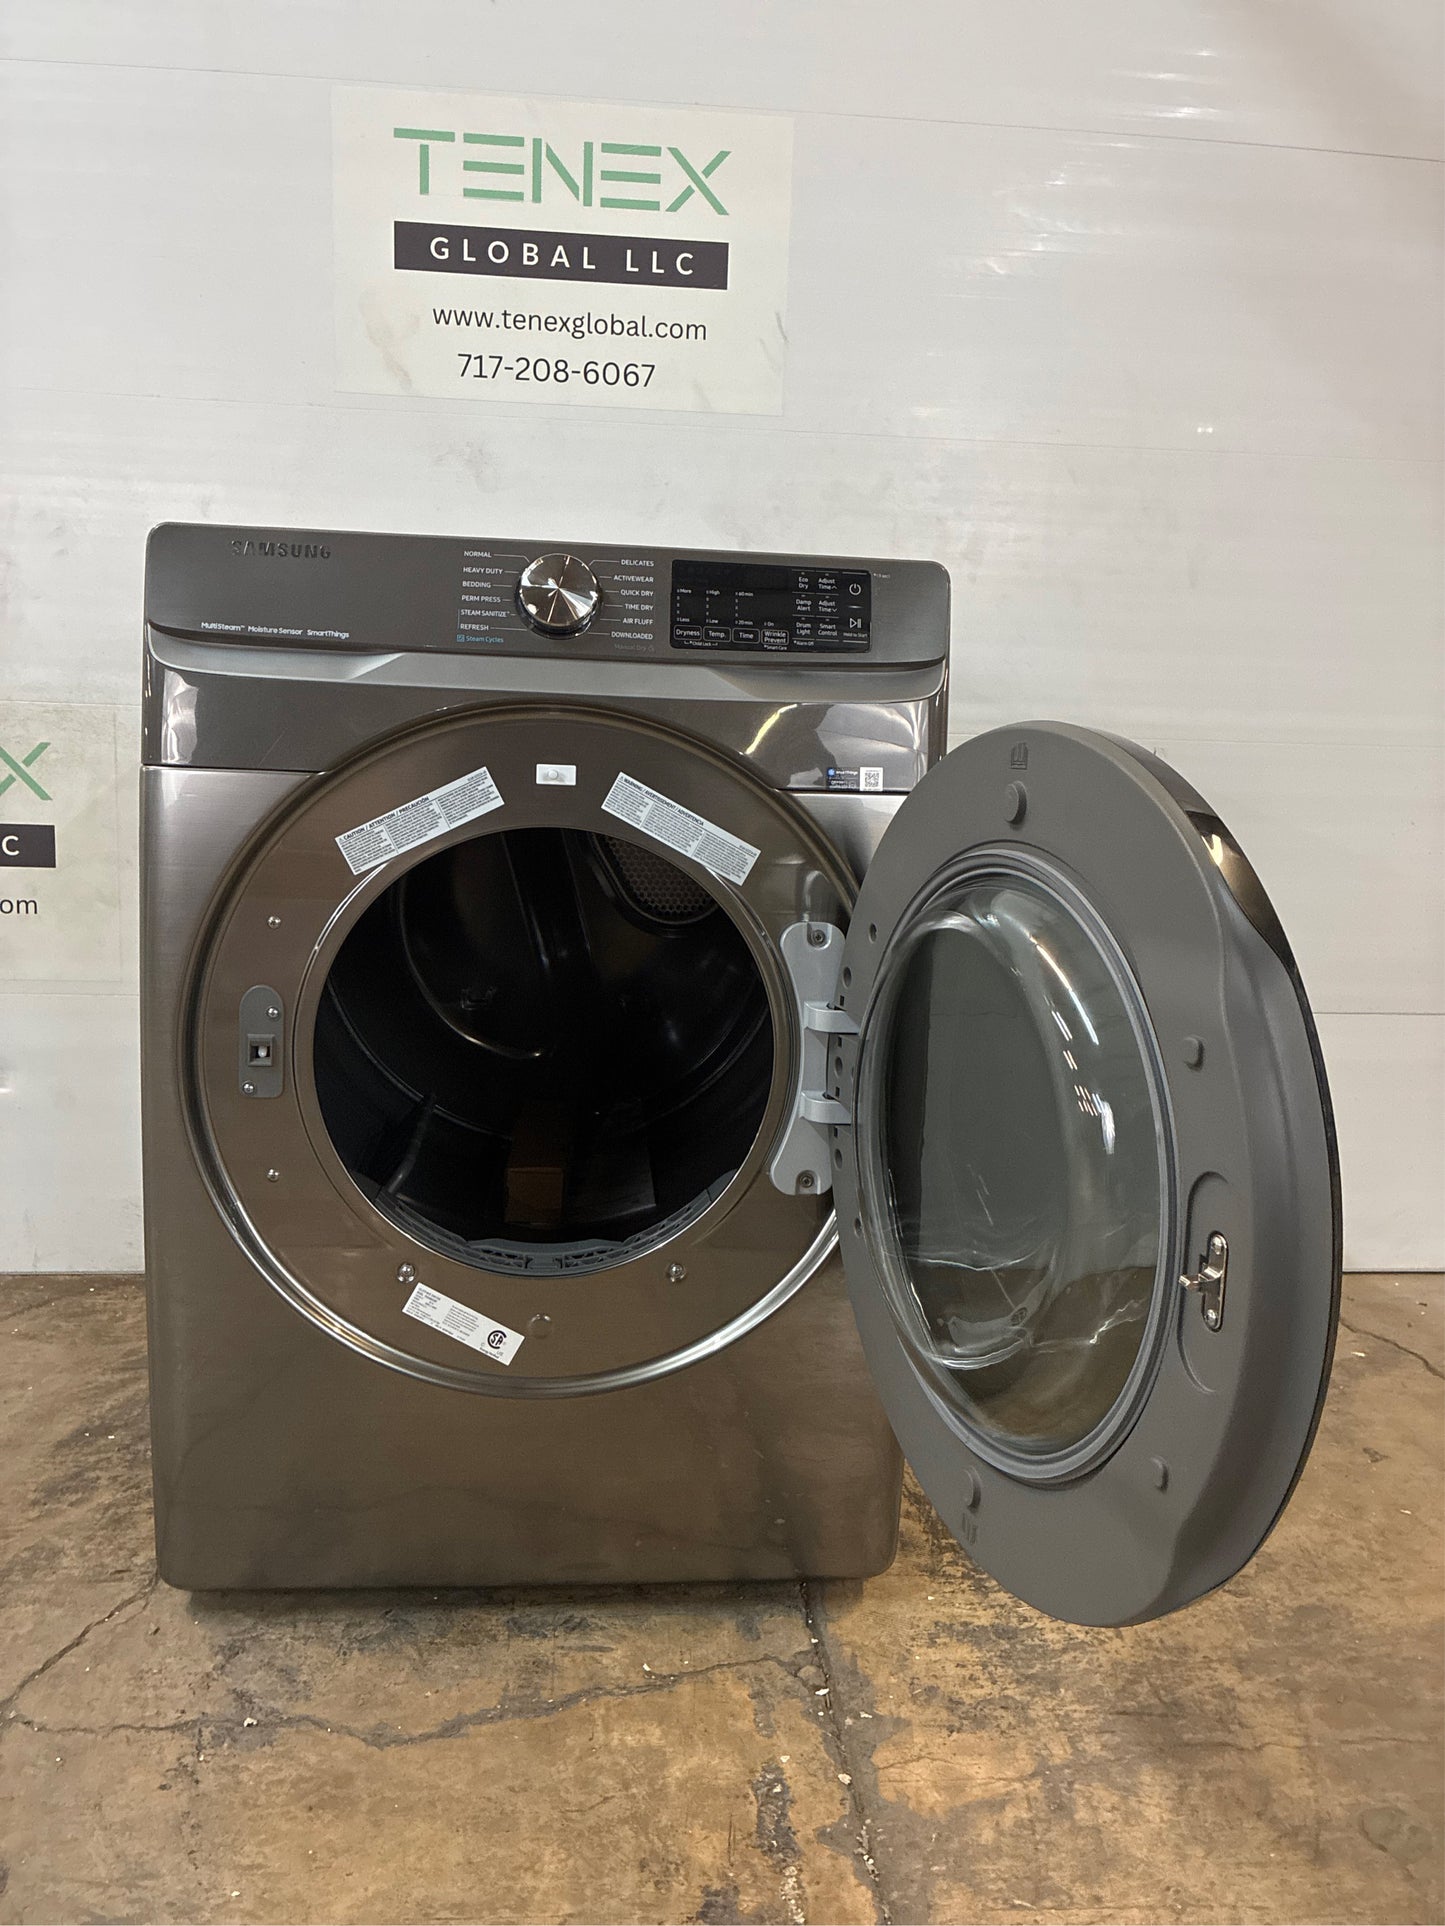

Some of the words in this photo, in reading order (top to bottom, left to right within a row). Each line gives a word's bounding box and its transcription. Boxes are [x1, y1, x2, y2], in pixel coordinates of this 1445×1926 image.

[394, 128, 731, 216] TENEX
[430, 237, 596, 270] GLOBAL
[626, 249, 694, 276] LLC
[433, 307, 707, 341] www.tenexglobal.com
[457, 353, 656, 387] 717-208-6067
[232, 541, 331, 558] SAMSUNG
[621, 559, 654, 567] DELICATES
[248, 626, 278, 634] Moisture
[307, 630, 349, 639] SmartThings
[486, 636, 504, 644] Cycles
[611, 631, 653, 640] DOWNLOADED
[624, 778, 643, 791] WARNING
[344, 827, 365, 840] CAUTION
[368, 813, 395, 829] ATTENTION
[2, 835, 20, 856] C
